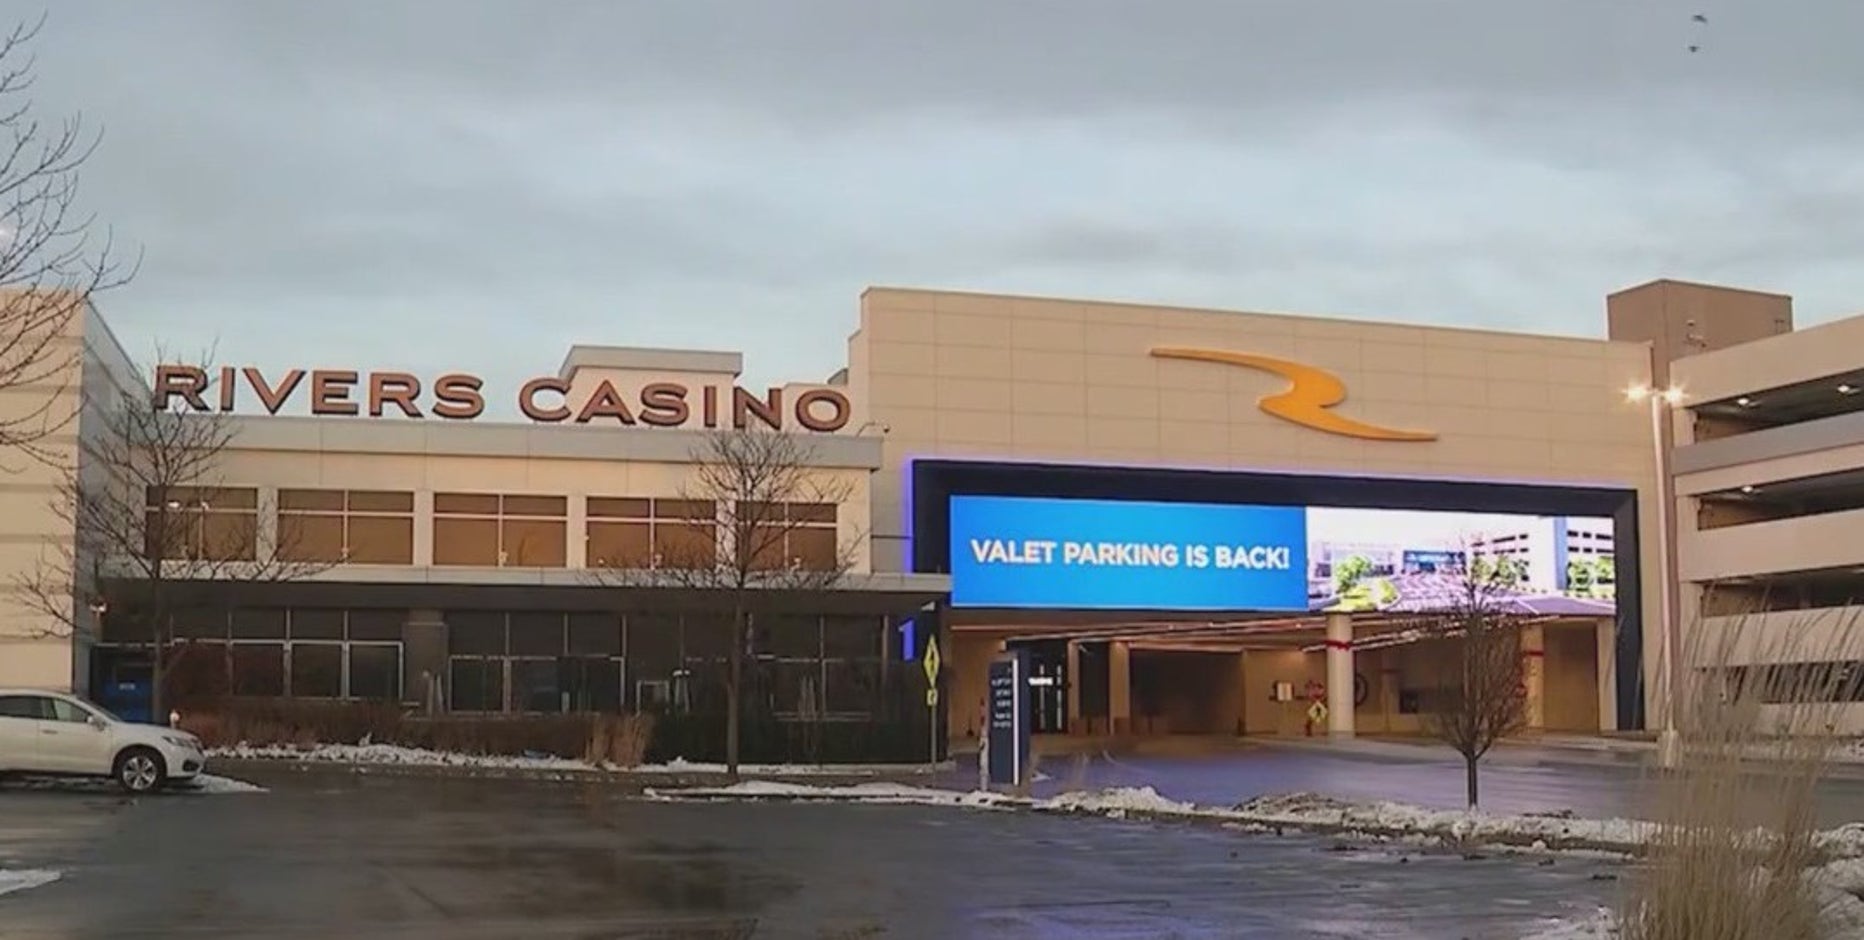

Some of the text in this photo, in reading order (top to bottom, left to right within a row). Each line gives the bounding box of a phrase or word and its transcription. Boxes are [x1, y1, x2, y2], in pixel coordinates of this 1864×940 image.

[153, 364, 851, 432] RIVERS CASINO
[971, 538, 1290, 570] VALET PARKING IS BACK!
